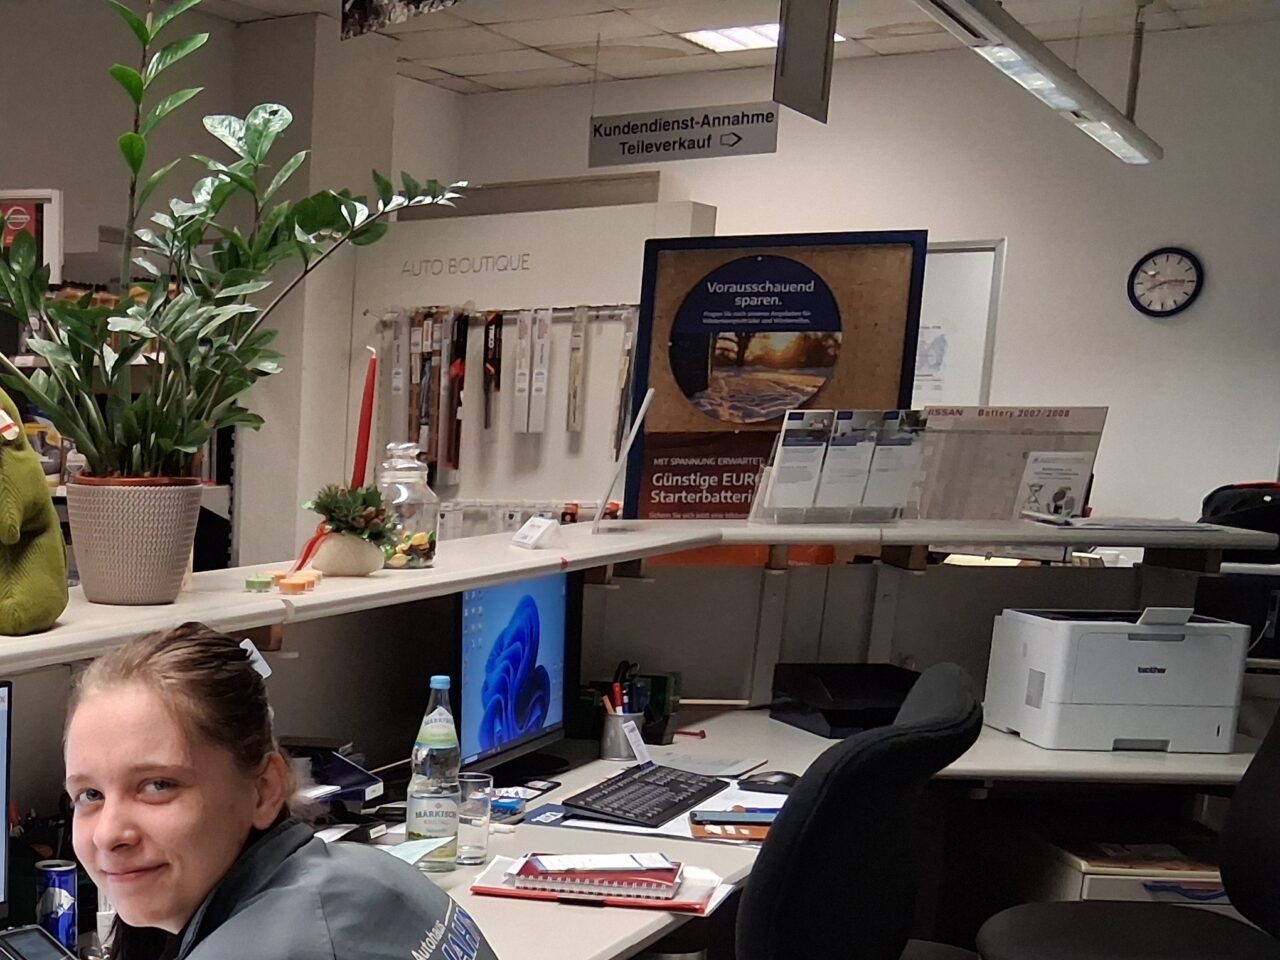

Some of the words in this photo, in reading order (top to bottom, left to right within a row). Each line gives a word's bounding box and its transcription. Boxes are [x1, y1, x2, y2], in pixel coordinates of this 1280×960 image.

[593, 111, 775, 138] Kundendienst-Annahme
[619, 134, 713, 155] Teileverkauf
[402, 259, 444, 277] AUTO
[448, 253, 530, 275] BOUTIQUE
[707, 280, 815, 293] Vorausschauend
[734, 296, 783, 308] sparen.
[977, 408, 1014, 419] Battery
[653, 457, 669, 466] MIT
[670, 457, 716, 466] SPANNUNG
[652, 472, 719, 490] Günstige
[650, 489, 752, 504] Starterbatteri
[1137, 666, 1167, 674] brother
